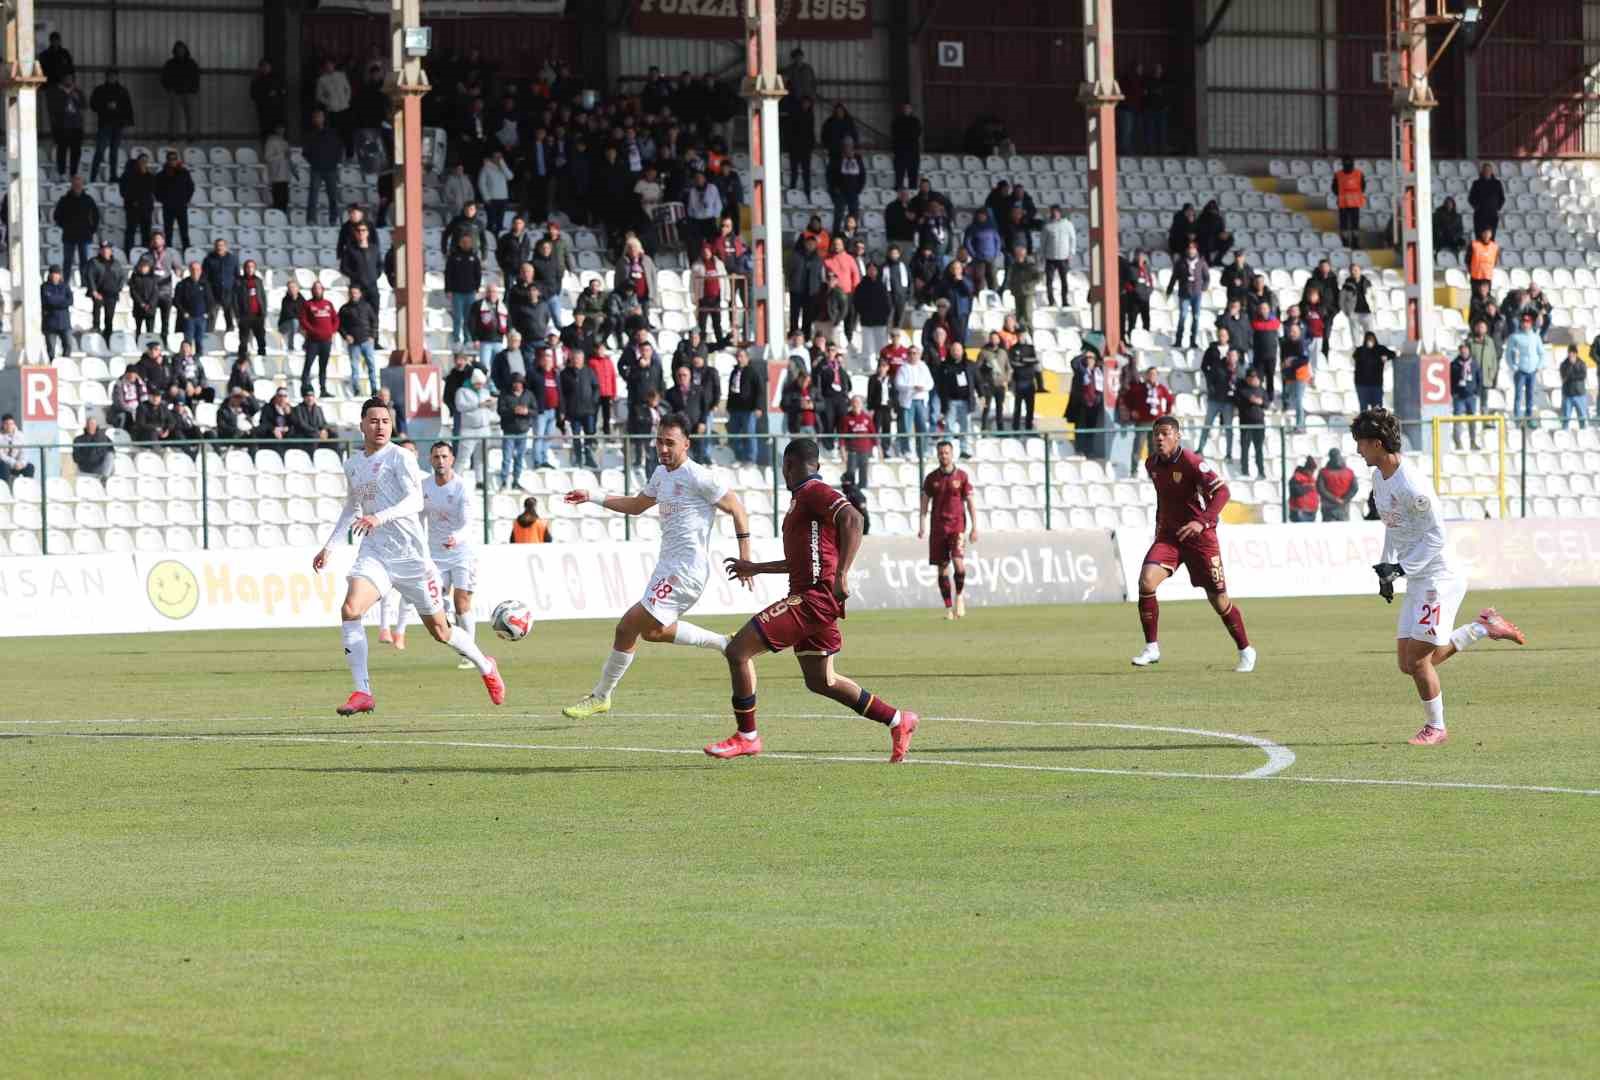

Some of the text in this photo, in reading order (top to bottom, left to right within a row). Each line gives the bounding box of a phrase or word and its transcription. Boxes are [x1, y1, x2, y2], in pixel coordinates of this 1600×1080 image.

[797, 0, 866, 20] 1965
[943, 45, 959, 63] D
[27, 373, 56, 416] R
[410, 371, 438, 412] M
[1427, 362, 1446, 401] S
[880, 548, 1034, 593] tredyol
[204, 562, 336, 615] Happy
[427, 580, 439, 598] 5
[769, 602, 788, 617] 9
[1418, 604, 1440, 625] 21
